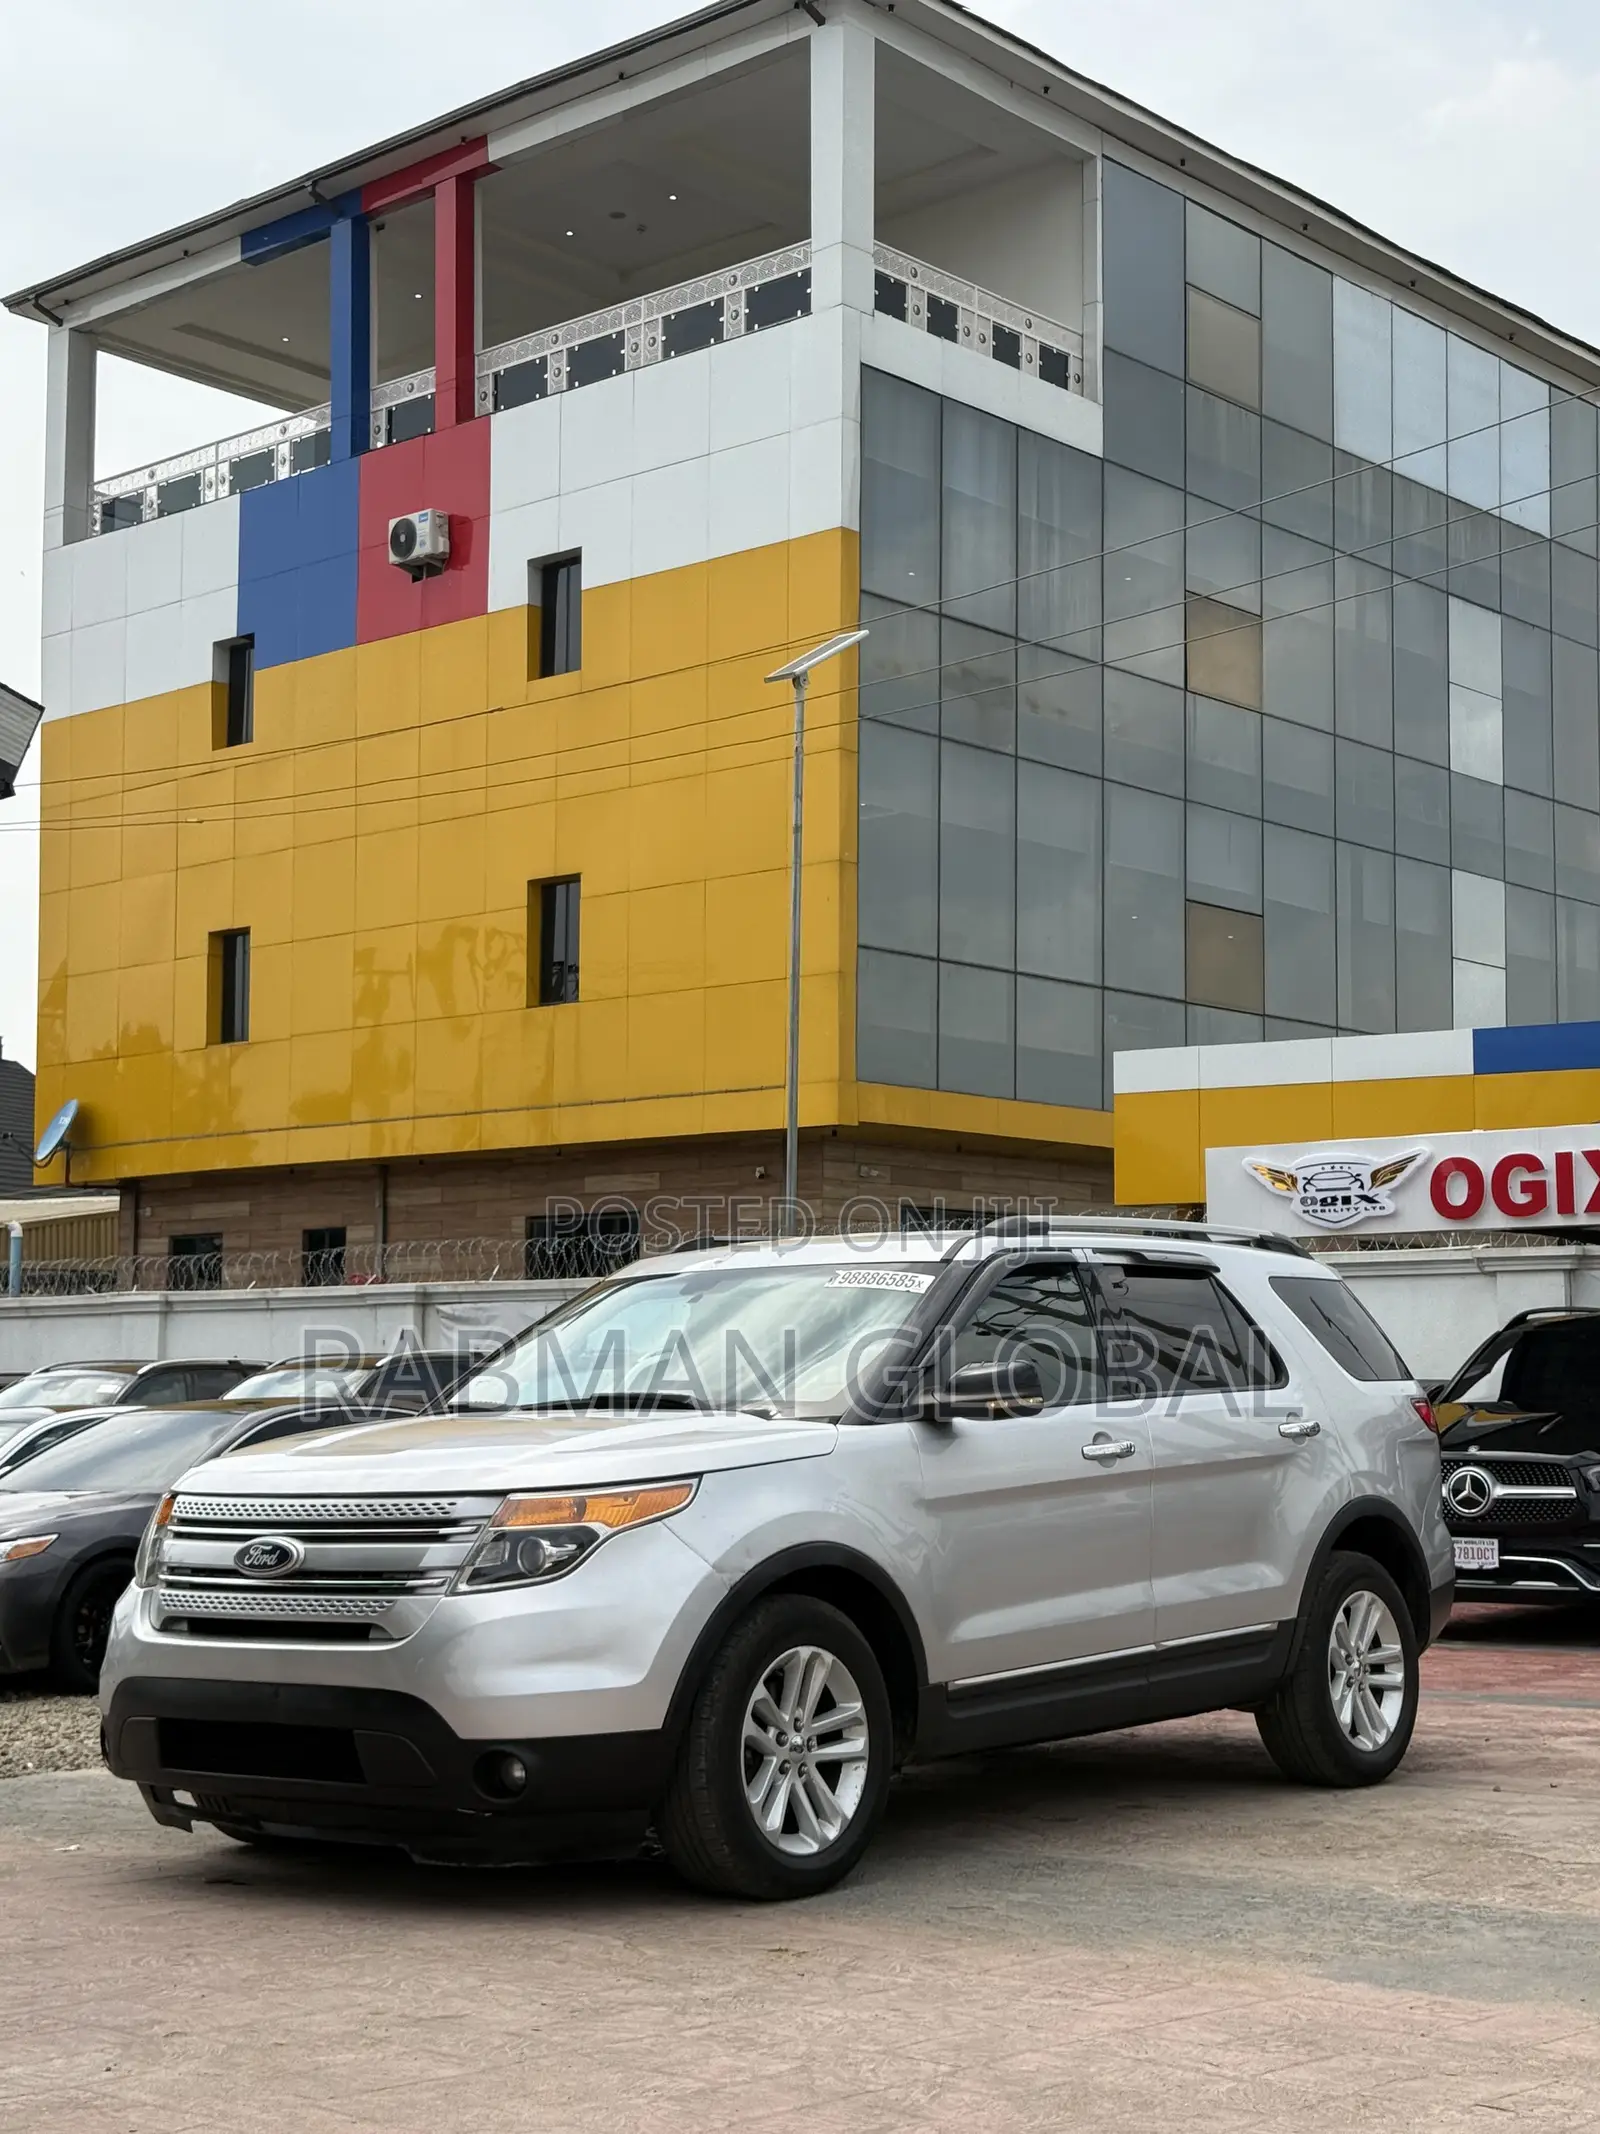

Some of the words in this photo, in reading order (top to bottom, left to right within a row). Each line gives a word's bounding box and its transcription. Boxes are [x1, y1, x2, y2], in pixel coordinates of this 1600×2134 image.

[1302, 1206, 1360, 1214] MOBILITY
[243, 1544, 281, 1566] Ford
[1453, 1546, 1496, 1561] 781DCT
